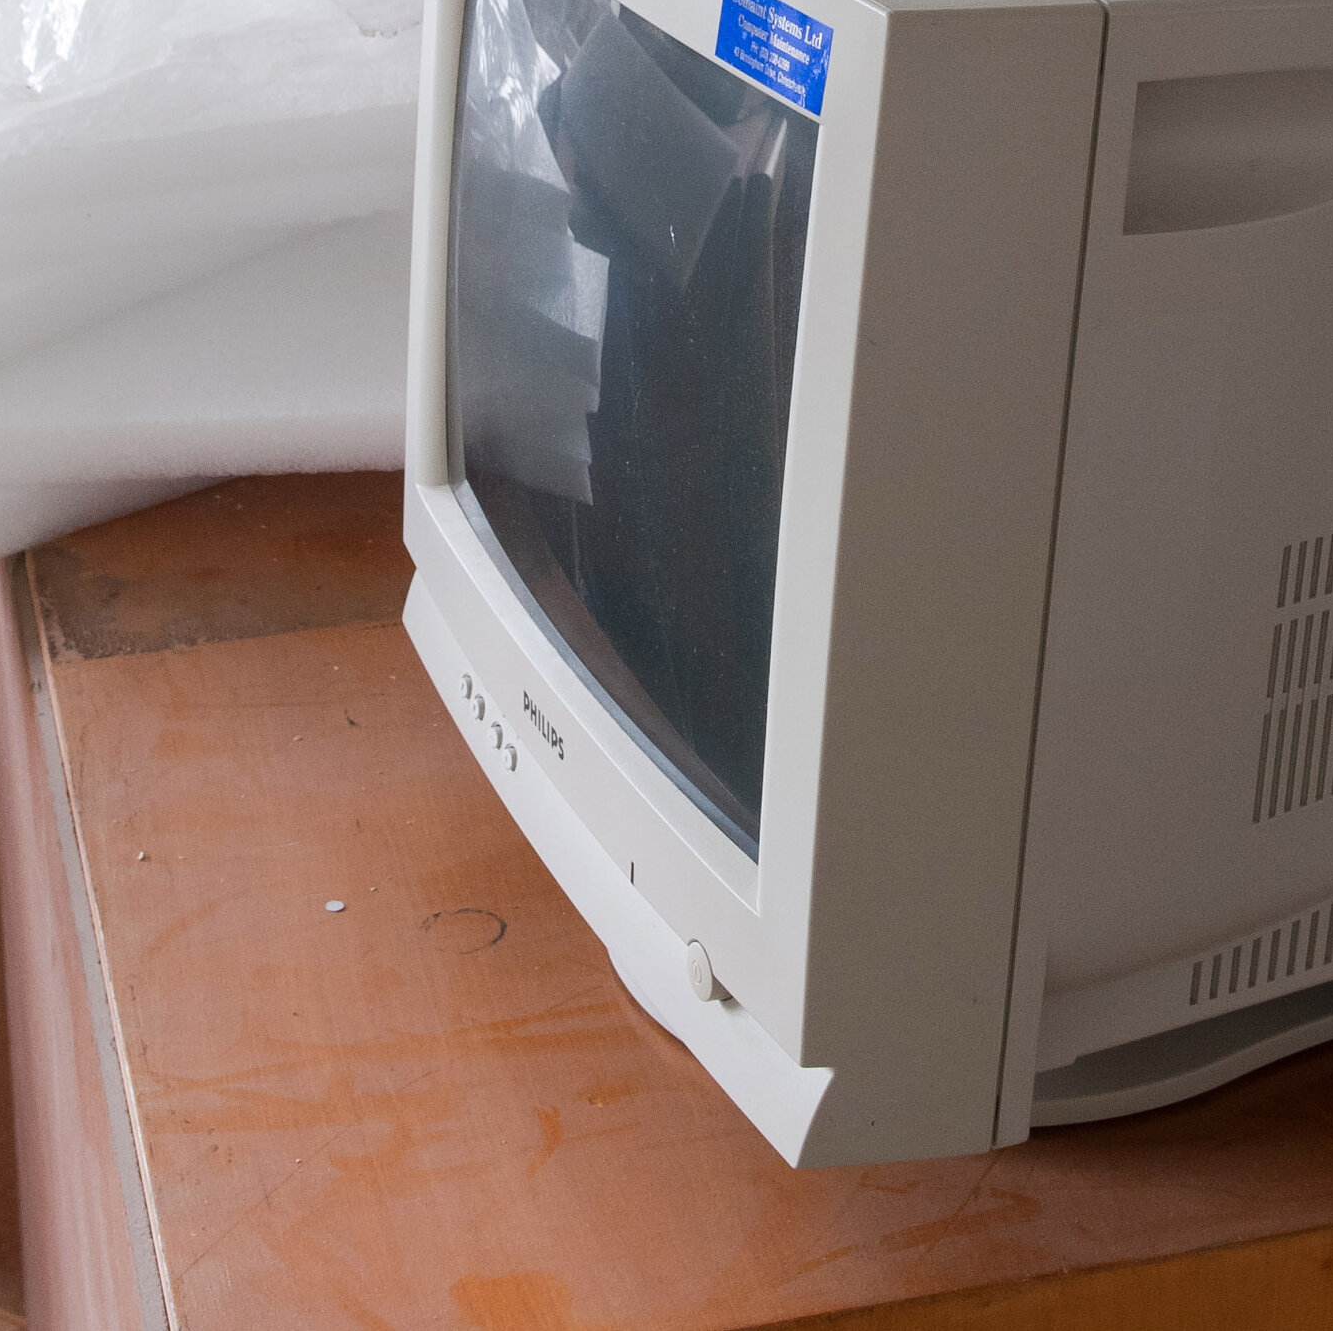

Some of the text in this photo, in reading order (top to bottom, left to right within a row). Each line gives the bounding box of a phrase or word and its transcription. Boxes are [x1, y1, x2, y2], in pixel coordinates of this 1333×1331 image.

[738, 13, 810, 66] Computer Maintenance
[767, 6, 803, 41] Systems
[804, 24, 822, 50] Ltd
[523, 690, 564, 760] PHILIPS
